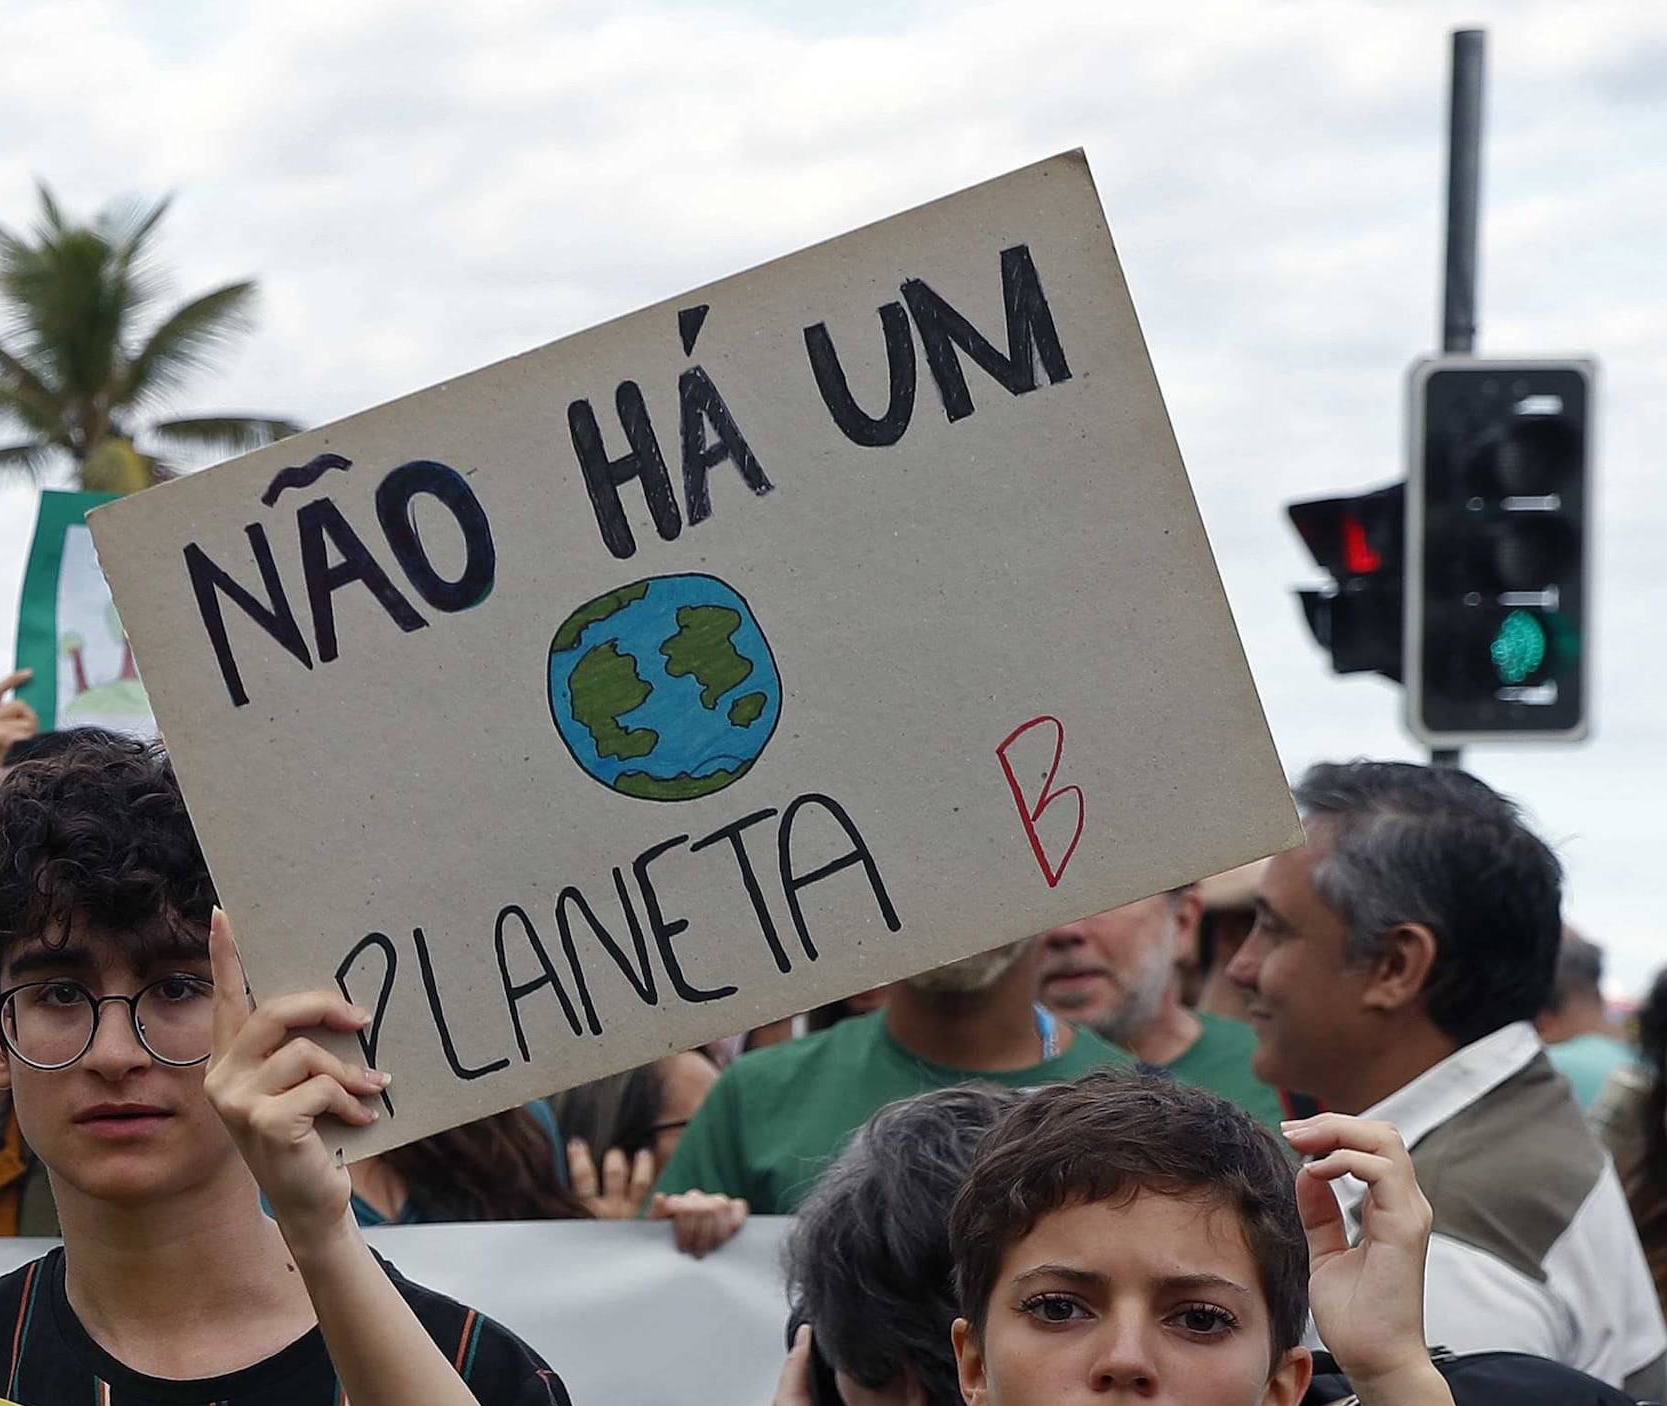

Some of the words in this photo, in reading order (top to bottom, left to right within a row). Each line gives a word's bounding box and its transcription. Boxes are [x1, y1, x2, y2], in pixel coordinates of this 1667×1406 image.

[182, 453, 496, 707] NÃO
[567, 305, 775, 560] HÁ
[803, 244, 1072, 448] UM
[334, 792, 902, 1117] PLANETA
[996, 713, 1085, 889] B
